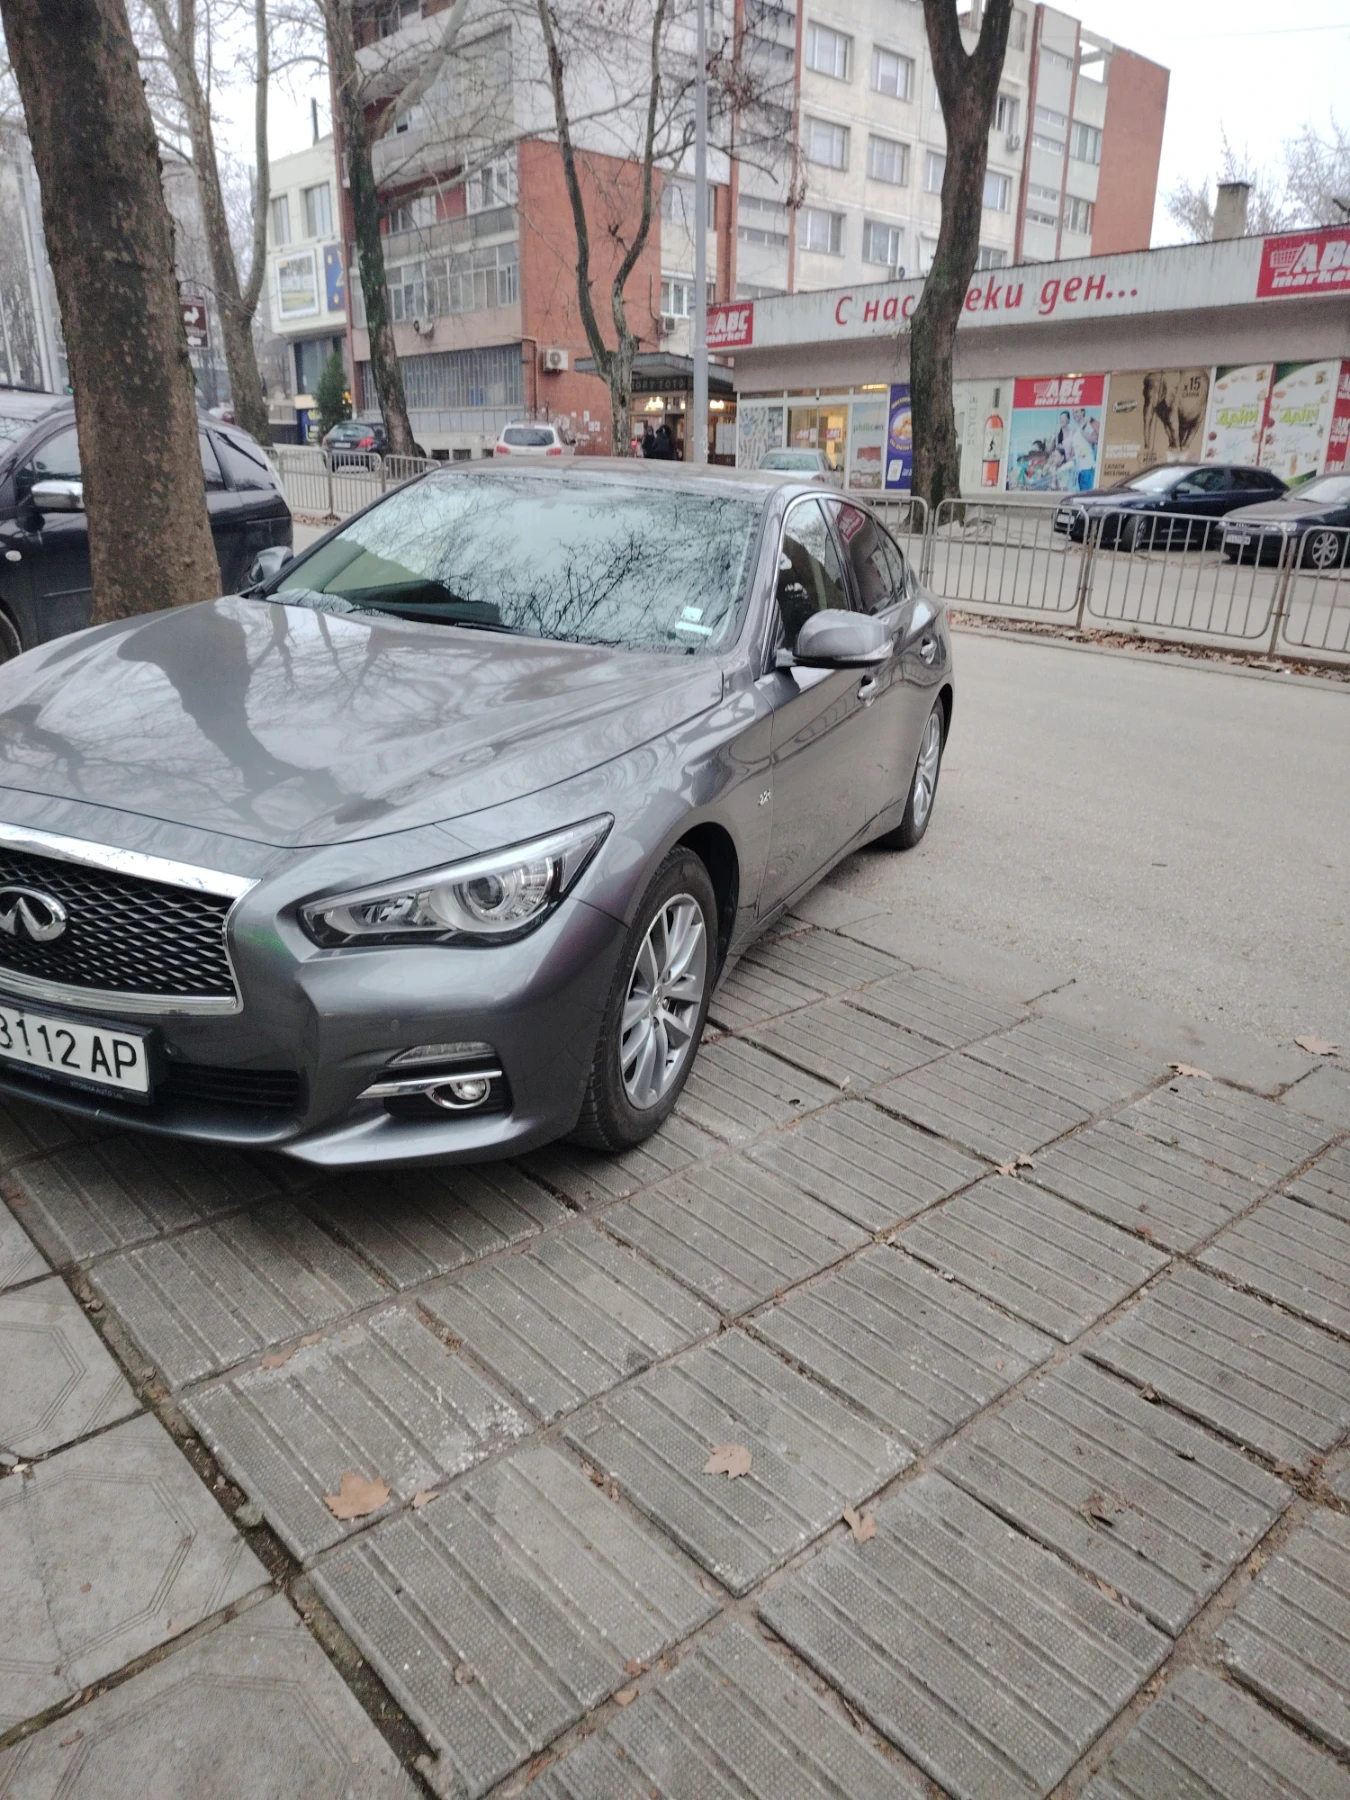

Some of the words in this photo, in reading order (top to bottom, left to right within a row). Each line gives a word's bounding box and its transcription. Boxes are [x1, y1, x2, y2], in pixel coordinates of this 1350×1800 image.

[835, 296, 853, 326] С
[863, 294, 915, 324] нас
[965, 276, 1024, 311] еки
[1038, 274, 1138, 315] ден...
[714, 309, 750, 334] ABC
[706, 330, 747, 343] market
[1046, 379, 1085, 398] ABC
[1035, 395, 1081, 406] market
[91, 1035, 137, 1079] AP
